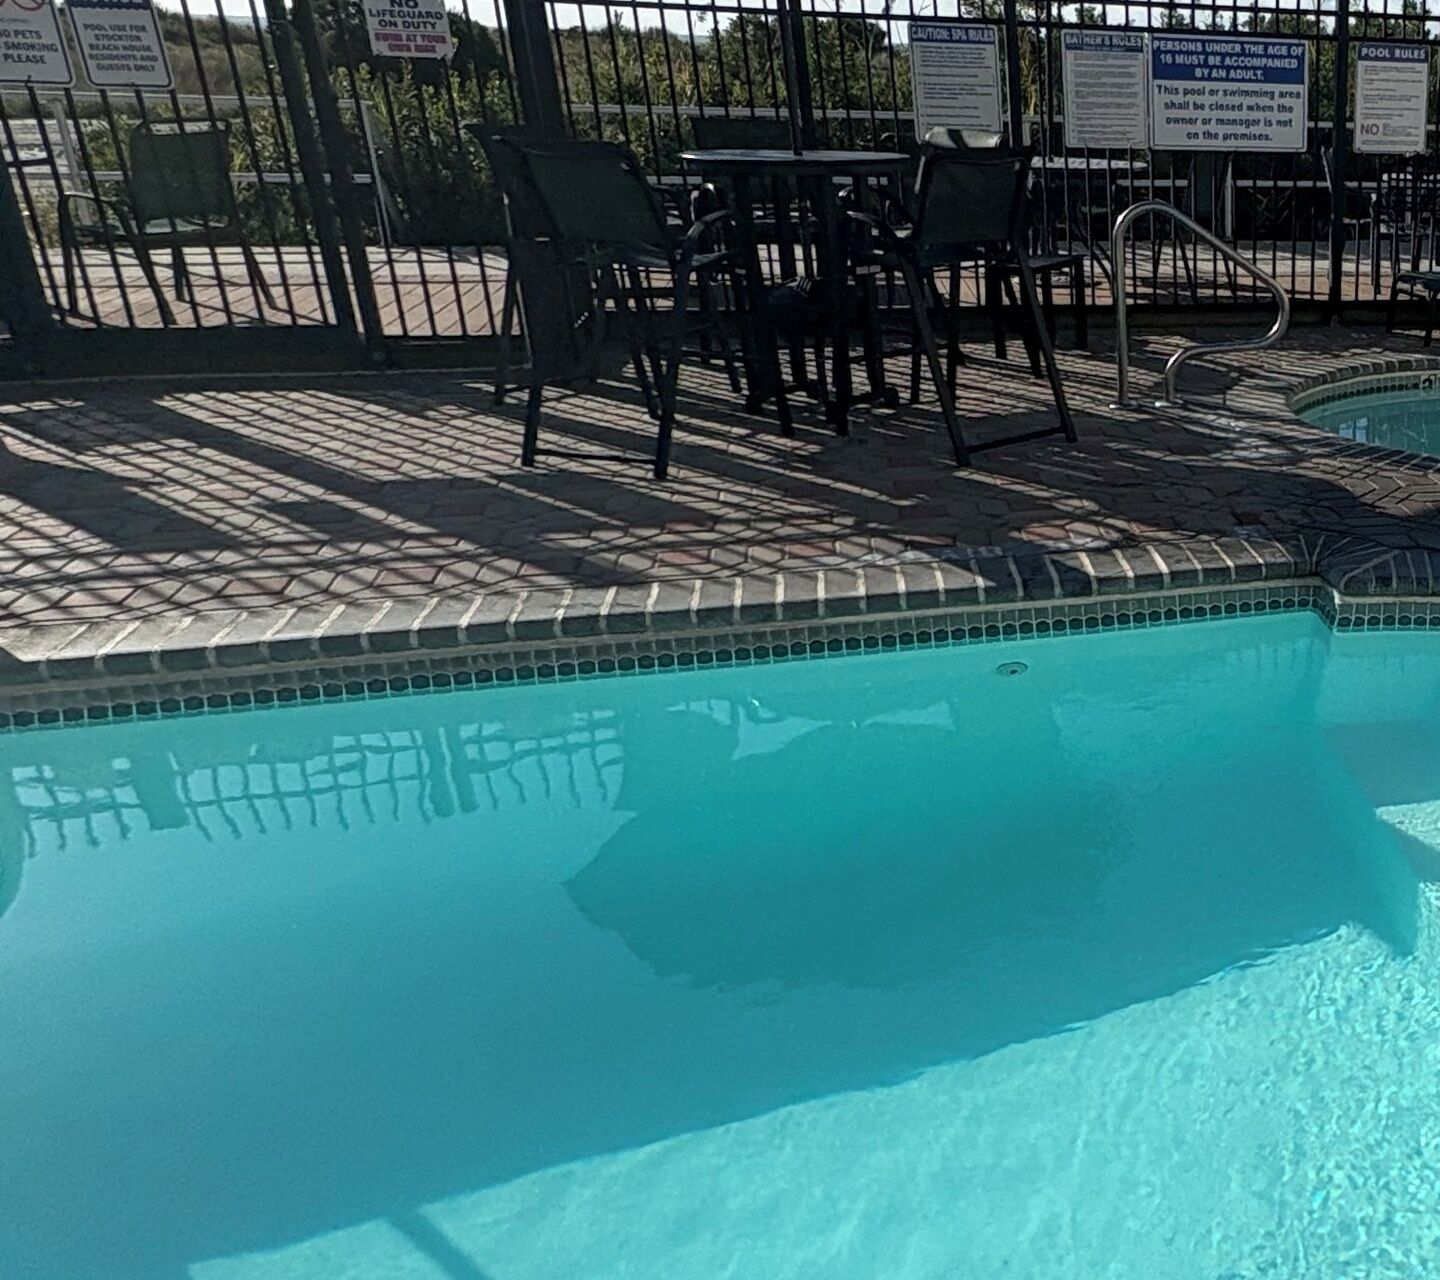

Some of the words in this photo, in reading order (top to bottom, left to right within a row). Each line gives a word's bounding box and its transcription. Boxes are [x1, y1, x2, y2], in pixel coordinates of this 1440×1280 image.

[368, 8, 444, 20] LIFEGUARD
[83, 23, 107, 32] POOL
[109, 24, 127, 32] USE
[129, 24, 148, 33] FOR
[378, 19, 398, 28] ON
[402, 20, 437, 30] DUTY
[13, 29, 42, 39] PETS
[406, 33, 417, 43] AT
[911, 25, 950, 40] CAUTION:
[951, 27, 967, 40] SPA
[968, 28, 994, 42] RULES
[4, 40, 59, 53] SMOKING
[1112, 35, 1142, 47] RULES
[1153, 39, 1203, 52] PERSONS
[1205, 42, 1241, 54] UNDER
[1244, 43, 1265, 55] THE
[1267, 44, 1288, 56] AGE
[1291, 46, 1304, 57] OF
[1361, 47, 1391, 58] POOL
[1394, 48, 1426, 59] RULES
[3, 53, 47, 64] PLEASE
[140, 54, 159, 62] AND
[1160, 53, 1172, 64] 16
[1175, 54, 1205, 65] MUST
[1208, 55, 1222, 66] BE
[1224, 56, 1298, 69] ACCOMPANIED
[1195, 67, 1210, 79] BY
[1211, 68, 1226, 79] AN
[1228, 69, 1264, 81] ADULT.
[1156, 84, 1180, 95] This
[1183, 85, 1206, 98] pool
[1222, 87, 1275, 101] swimming
[1278, 90, 1301, 99] area
[1164, 100, 1189, 111] shall
[1193, 101, 1206, 111] be
[1209, 101, 1244, 112] closed
[1246, 103, 1274, 113] when
[1277, 103, 1294, 113] the
[1166, 116, 1199, 125] owner
[1202, 117, 1213, 126] or
[1216, 117, 1261, 129] manager
[1264, 117, 1273, 127] is
[1276, 117, 1293, 128] not
[1361, 123, 1380, 136] NO
[1186, 131, 1199, 140] on
[1203, 129, 1219, 140] the
[1222, 130, 1273, 144] premises.
